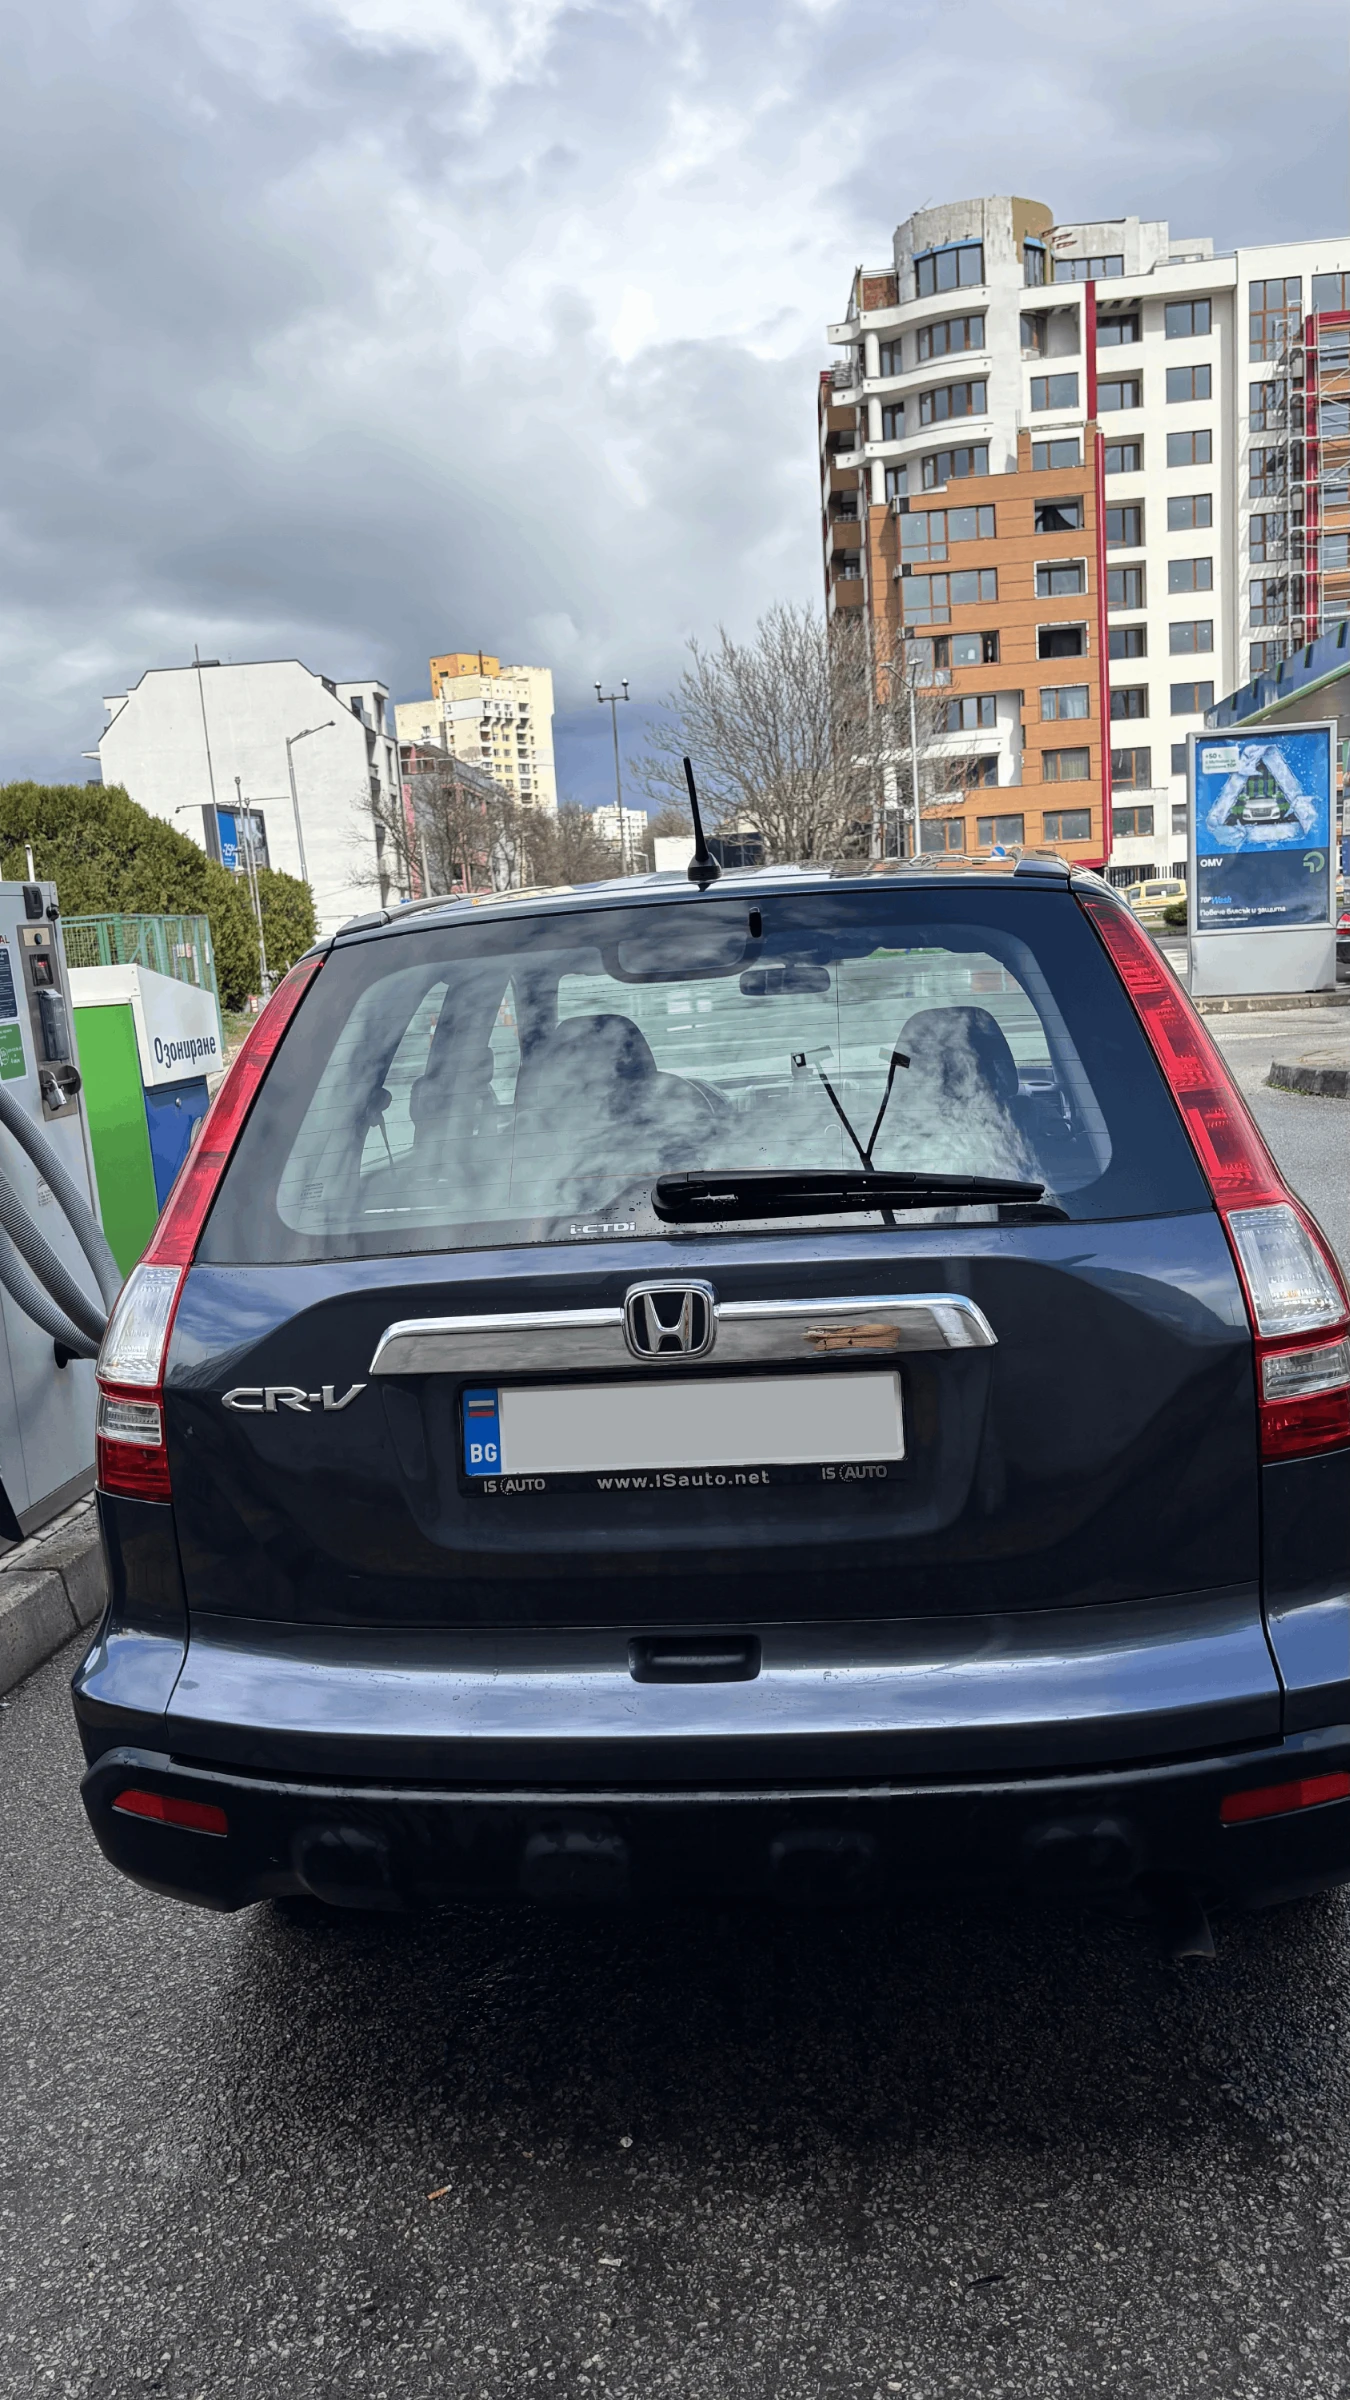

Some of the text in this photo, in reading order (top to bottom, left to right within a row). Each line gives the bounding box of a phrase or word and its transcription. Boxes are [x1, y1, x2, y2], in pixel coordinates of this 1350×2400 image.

[1200, 858, 1223, 868] OMV
[1200, 908, 1226, 917] Повече
[1226, 906, 1251, 915] блясък
[1257, 906, 1286, 915] защита
[154, 1036, 217, 1069] Озониране
[570, 1222, 637, 1235] i-CTDi
[221, 1384, 368, 1412] CR-V
[470, 1443, 498, 1463] BG
[597, 1470, 770, 1490] www.ISauto.net
[821, 1467, 836, 1480] IS
[483, 1480, 497, 1493] IS
